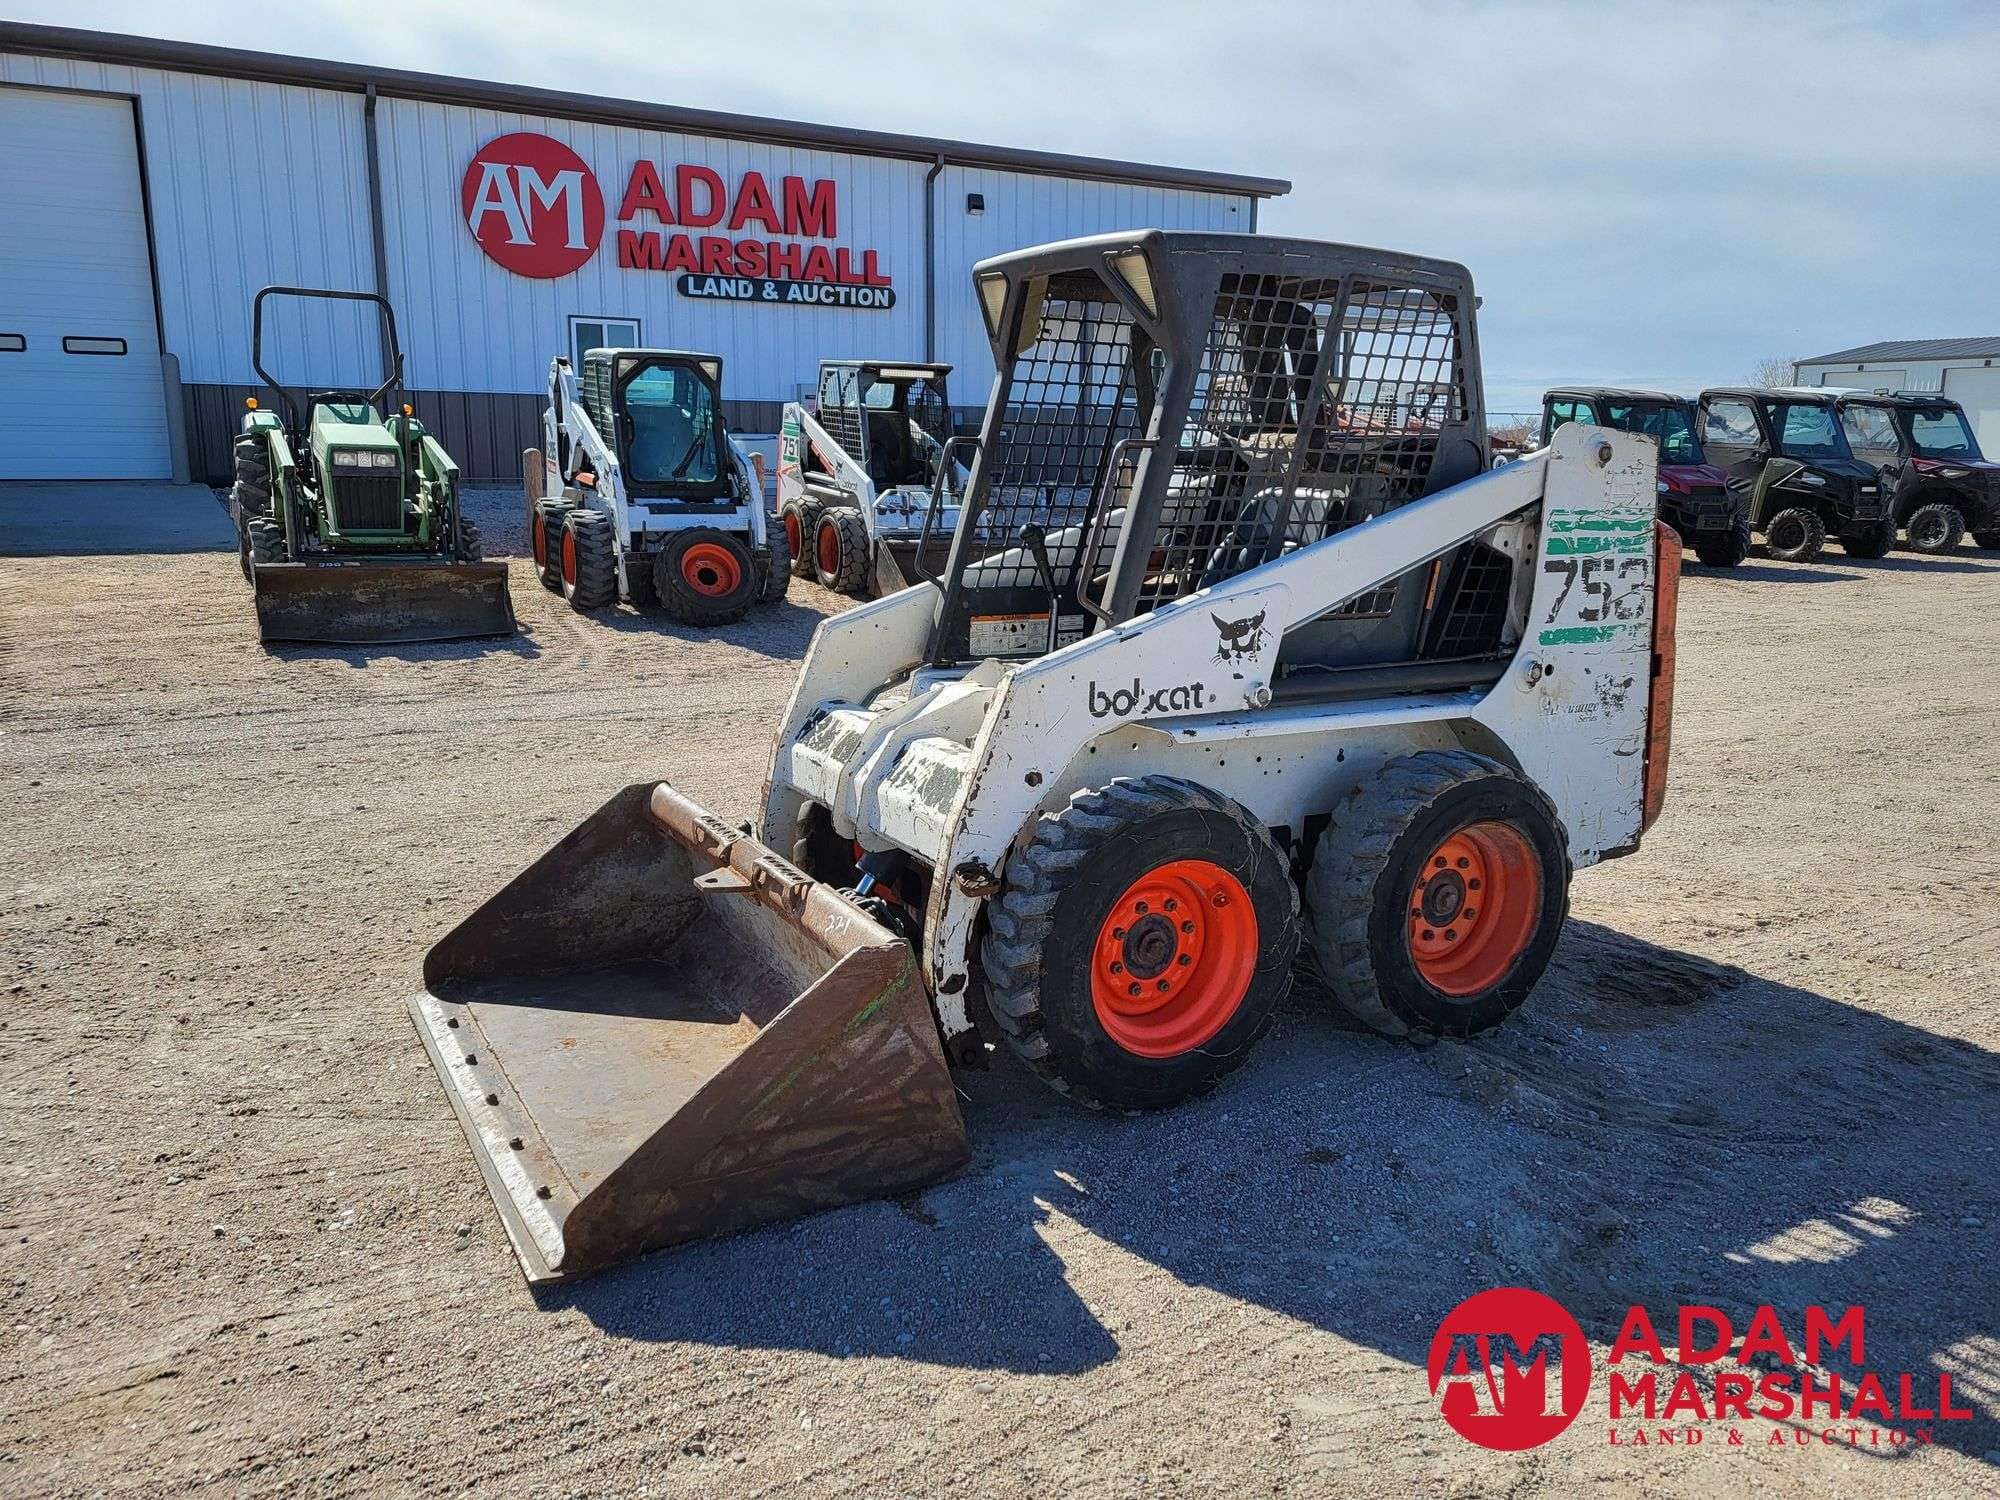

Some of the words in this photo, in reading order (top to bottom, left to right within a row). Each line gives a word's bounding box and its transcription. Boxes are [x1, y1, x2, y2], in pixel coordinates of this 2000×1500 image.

[467, 161, 589, 250] AM
[617, 159, 837, 239] ADAM
[617, 229, 893, 286] MARSHALL
[687, 276, 755, 299] LAND
[762, 281, 779, 301] &
[787, 283, 890, 307] AUCTION
[783, 436, 799, 457] 751
